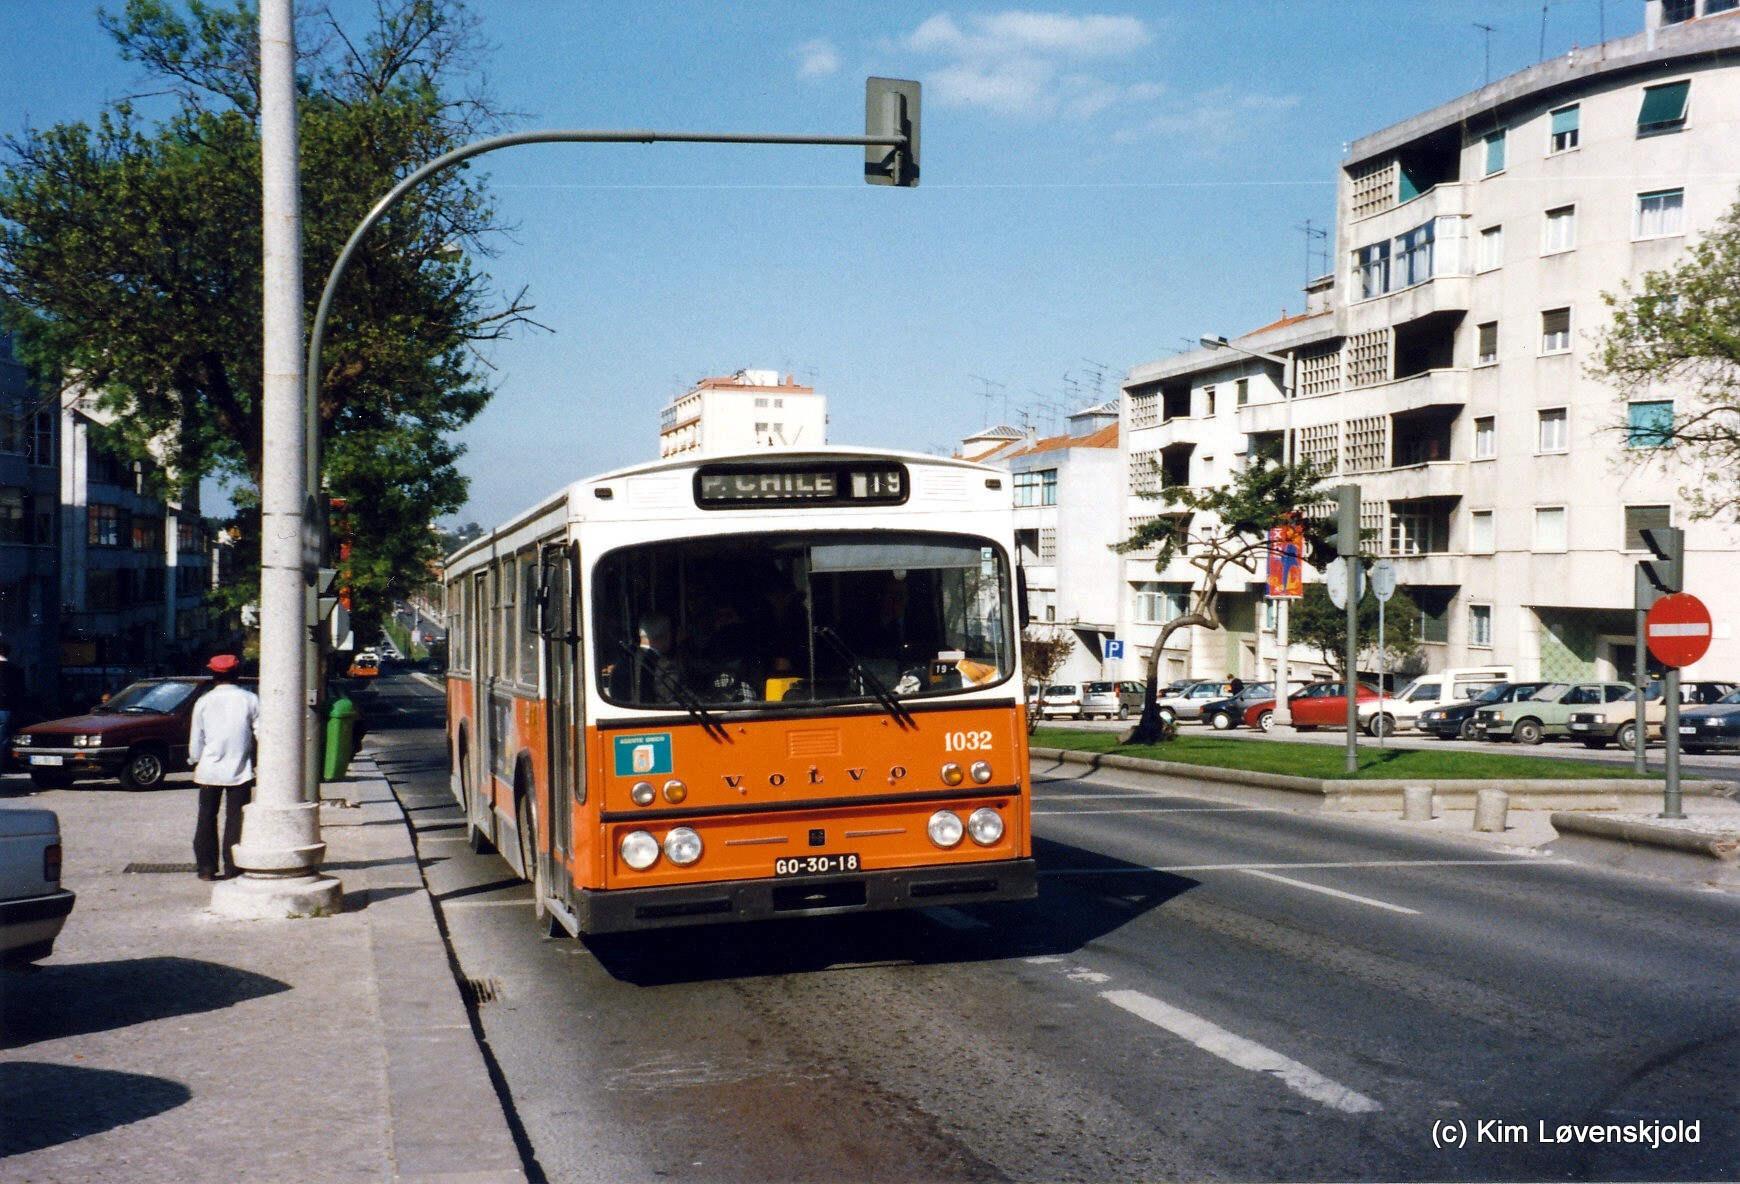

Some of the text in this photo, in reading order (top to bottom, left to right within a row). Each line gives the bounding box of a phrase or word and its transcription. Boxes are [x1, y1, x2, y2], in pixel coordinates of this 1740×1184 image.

[735, 474, 833, 492] CHILE
[874, 472, 900, 493] 19
[1109, 641, 1120, 658] P
[945, 730, 993, 752] 1032
[722, 766, 907, 789] VOLVO
[776, 855, 858, 875] GO-30-18
